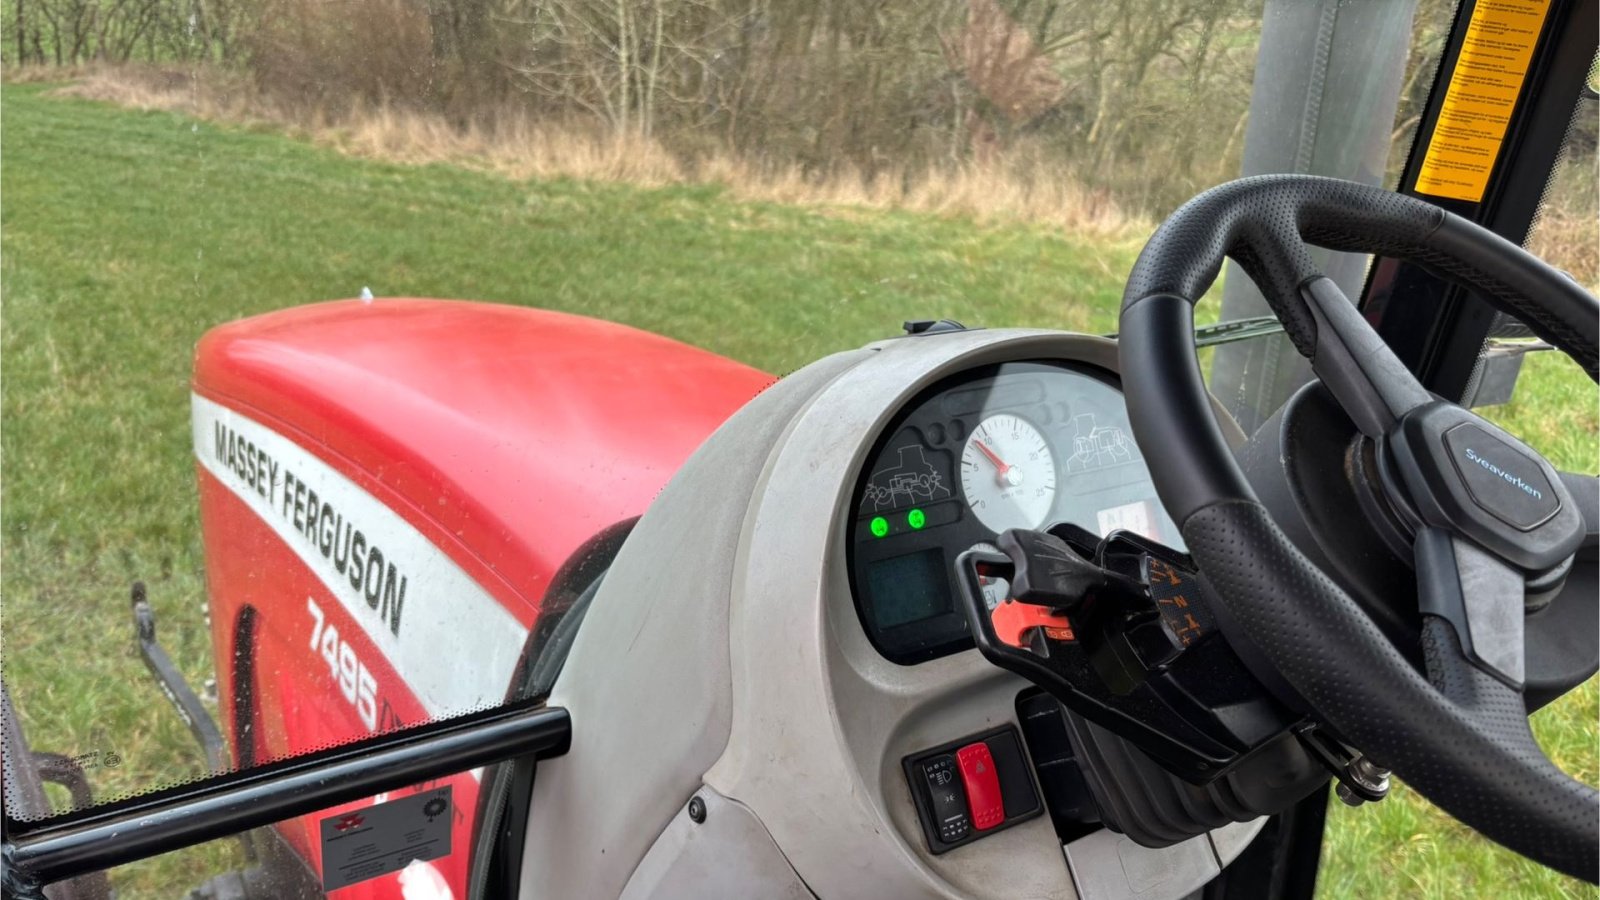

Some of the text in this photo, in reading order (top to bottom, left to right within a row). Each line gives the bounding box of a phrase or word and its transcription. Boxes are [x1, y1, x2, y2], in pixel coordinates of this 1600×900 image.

[973, 464, 980, 472] 5
[1465, 448, 1542, 500] Sveaverken
[215, 419, 408, 638] MASSEY FERGUSON
[307, 595, 378, 733] 7495
